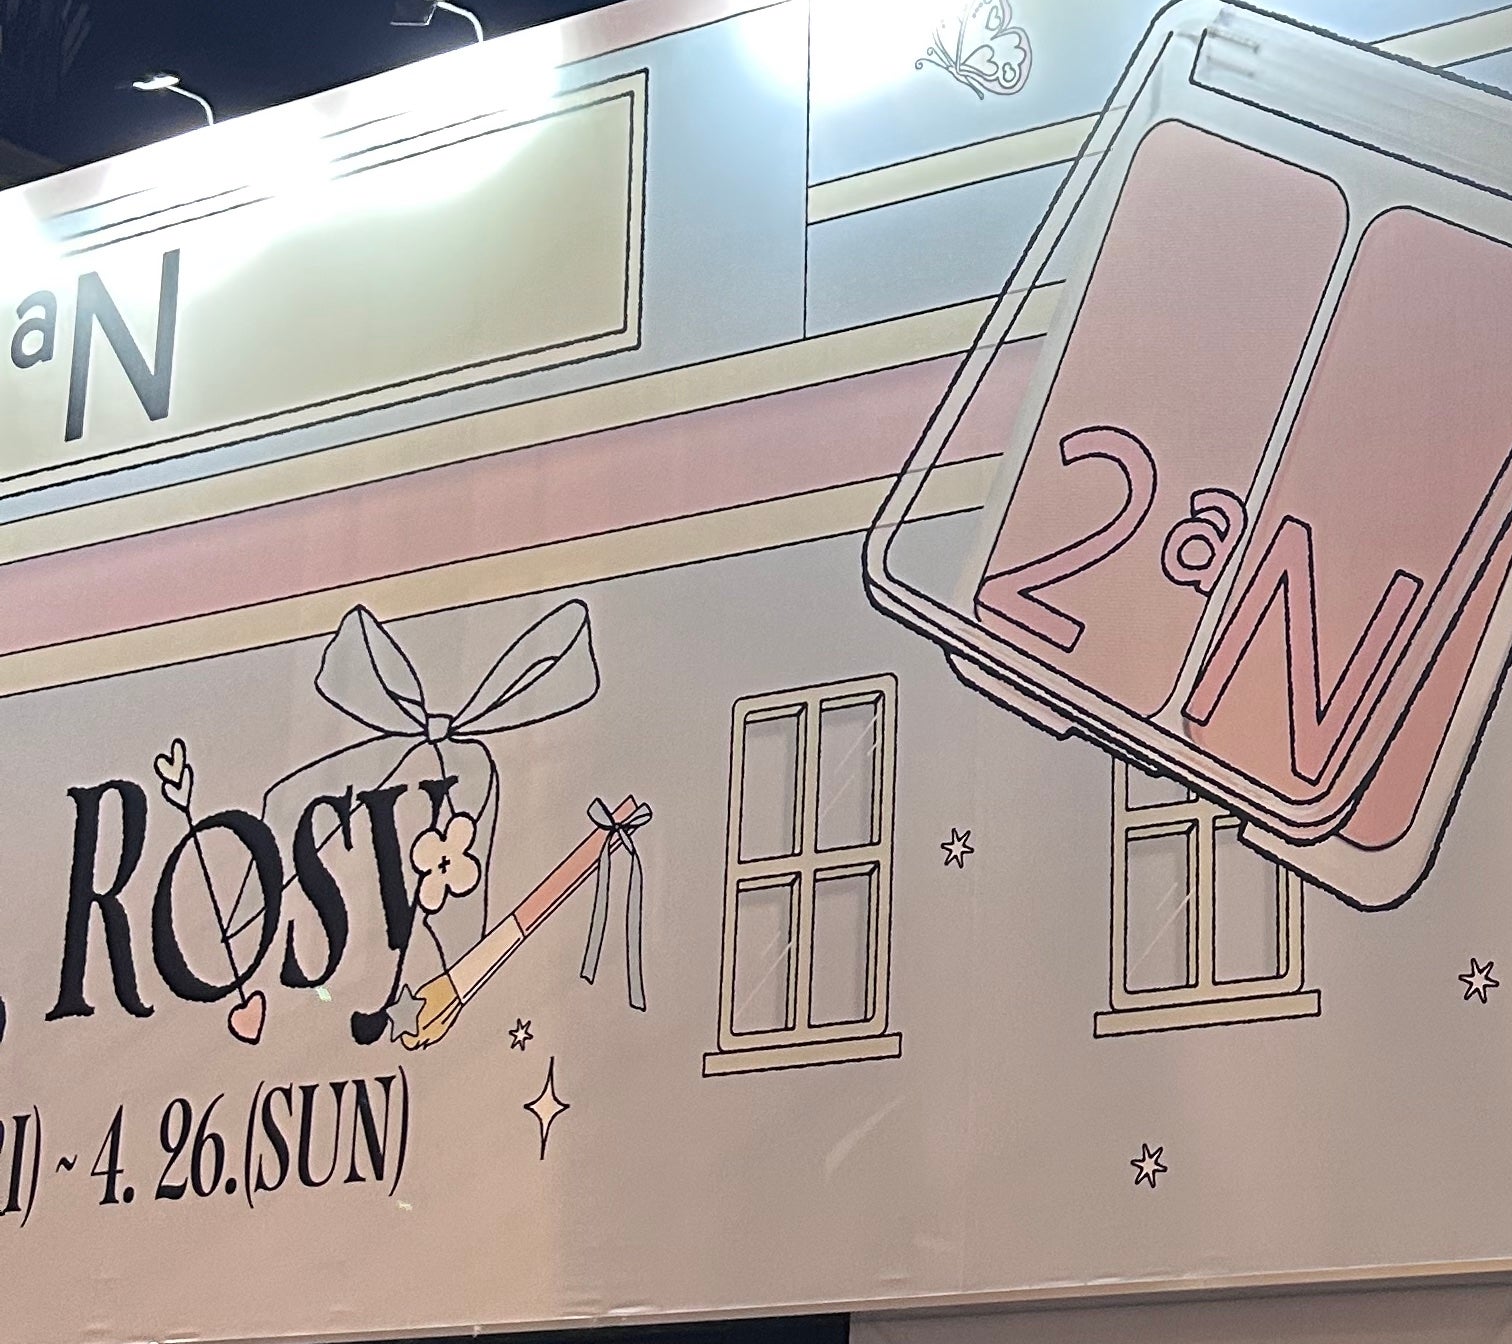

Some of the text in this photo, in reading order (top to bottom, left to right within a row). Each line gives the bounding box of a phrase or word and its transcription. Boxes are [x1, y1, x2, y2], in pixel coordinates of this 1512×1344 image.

[973, 426, 1424, 786] 2aN
[0, 1105, 41, 1228] I)
[91, 1104, 135, 1205] 4.
